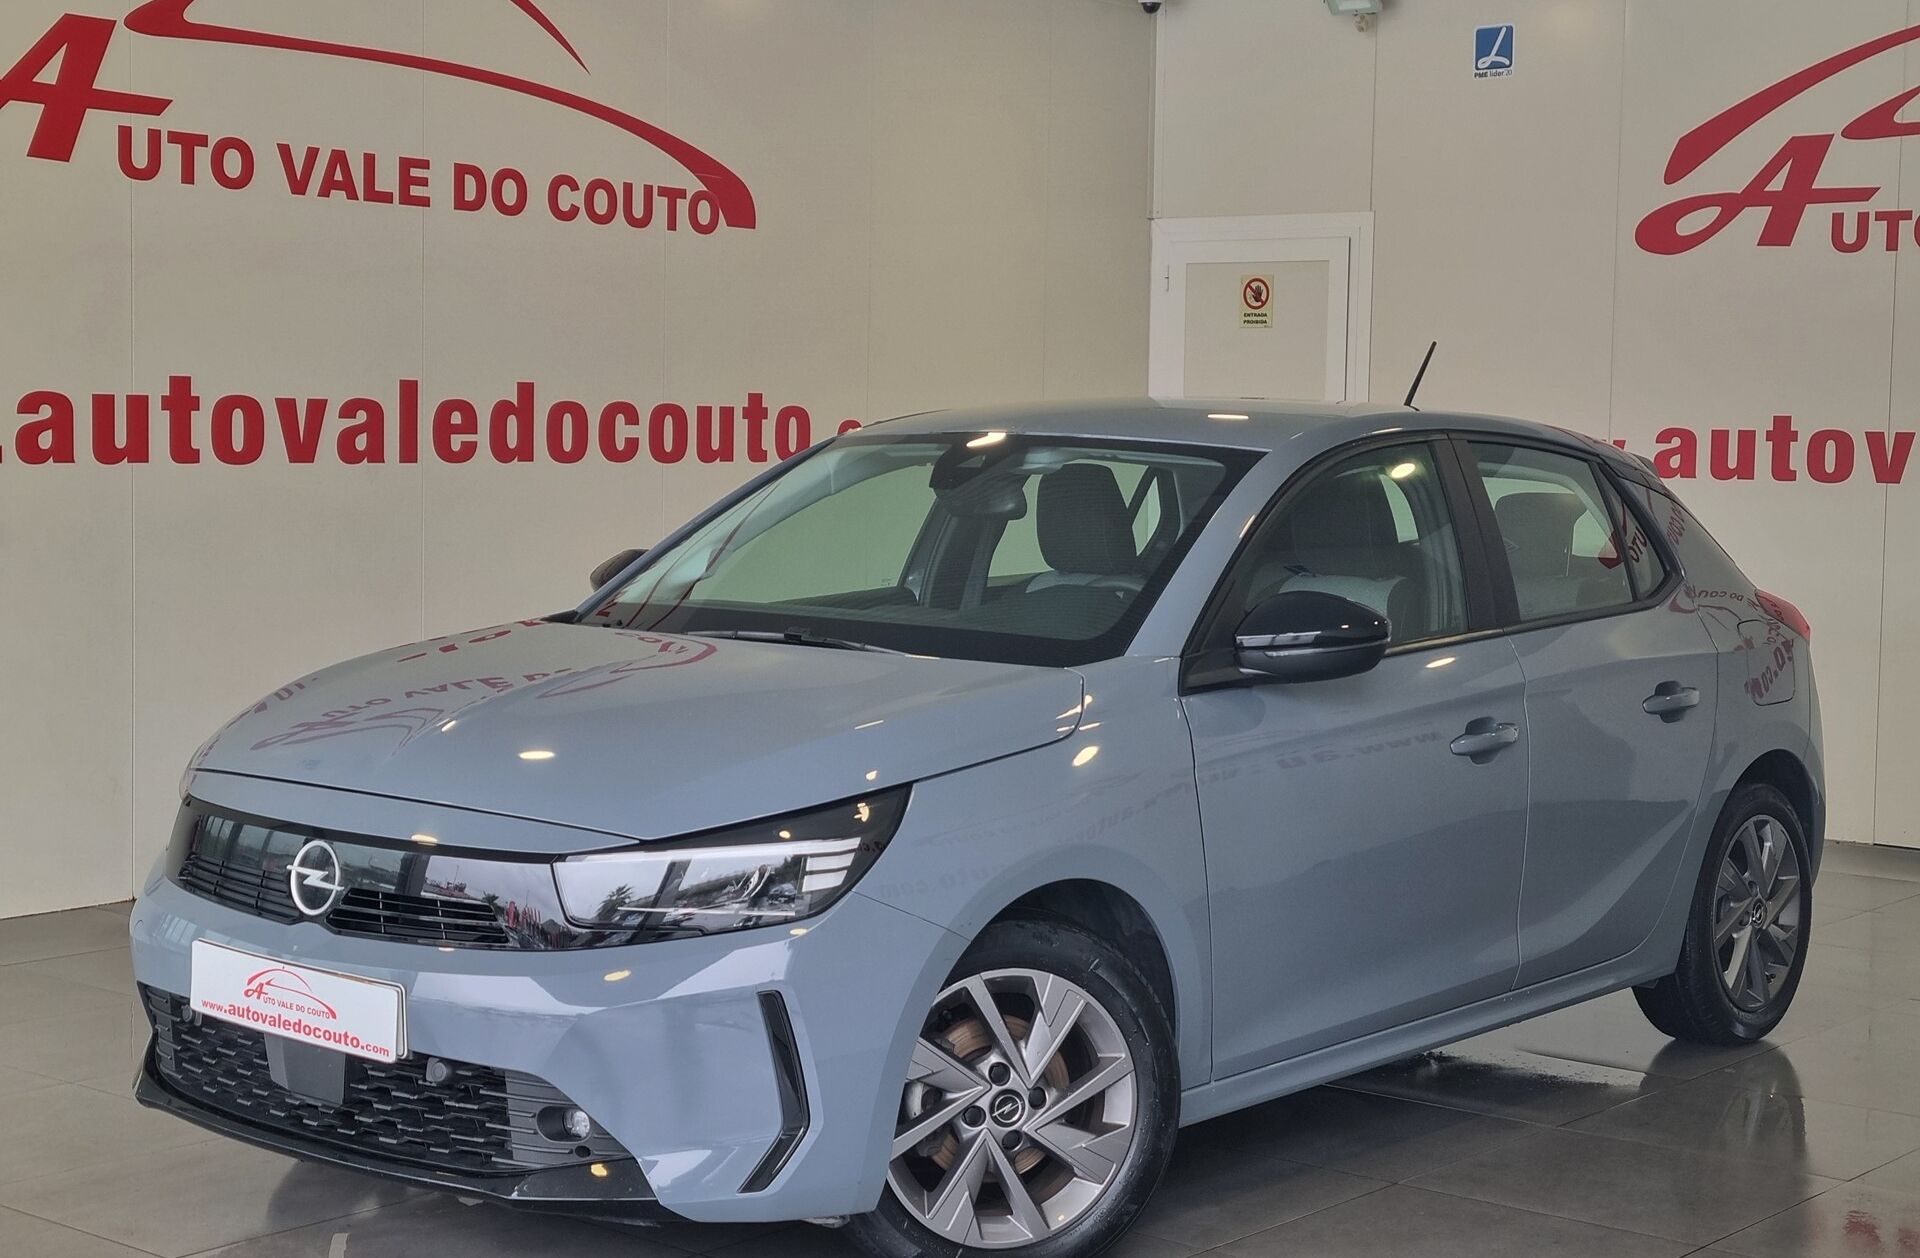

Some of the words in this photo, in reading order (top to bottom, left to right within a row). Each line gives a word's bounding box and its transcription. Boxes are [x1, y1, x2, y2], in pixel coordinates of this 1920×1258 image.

[277, 142, 431, 208] VALE
[453, 163, 528, 217] DO
[547, 173, 721, 235] COUTO
[1635, 134, 1920, 255] AUT
[0, 374, 862, 466] autovaledocouto
[1602, 415, 1916, 484] autov
[201, 999, 390, 1057] www.autovaledocouto.com
[244, 982, 276, 1004] AUTO
[277, 1000, 294, 1011] VALE
[295, 1004, 305, 1013] DO
[307, 1007, 330, 1019] COUTO
